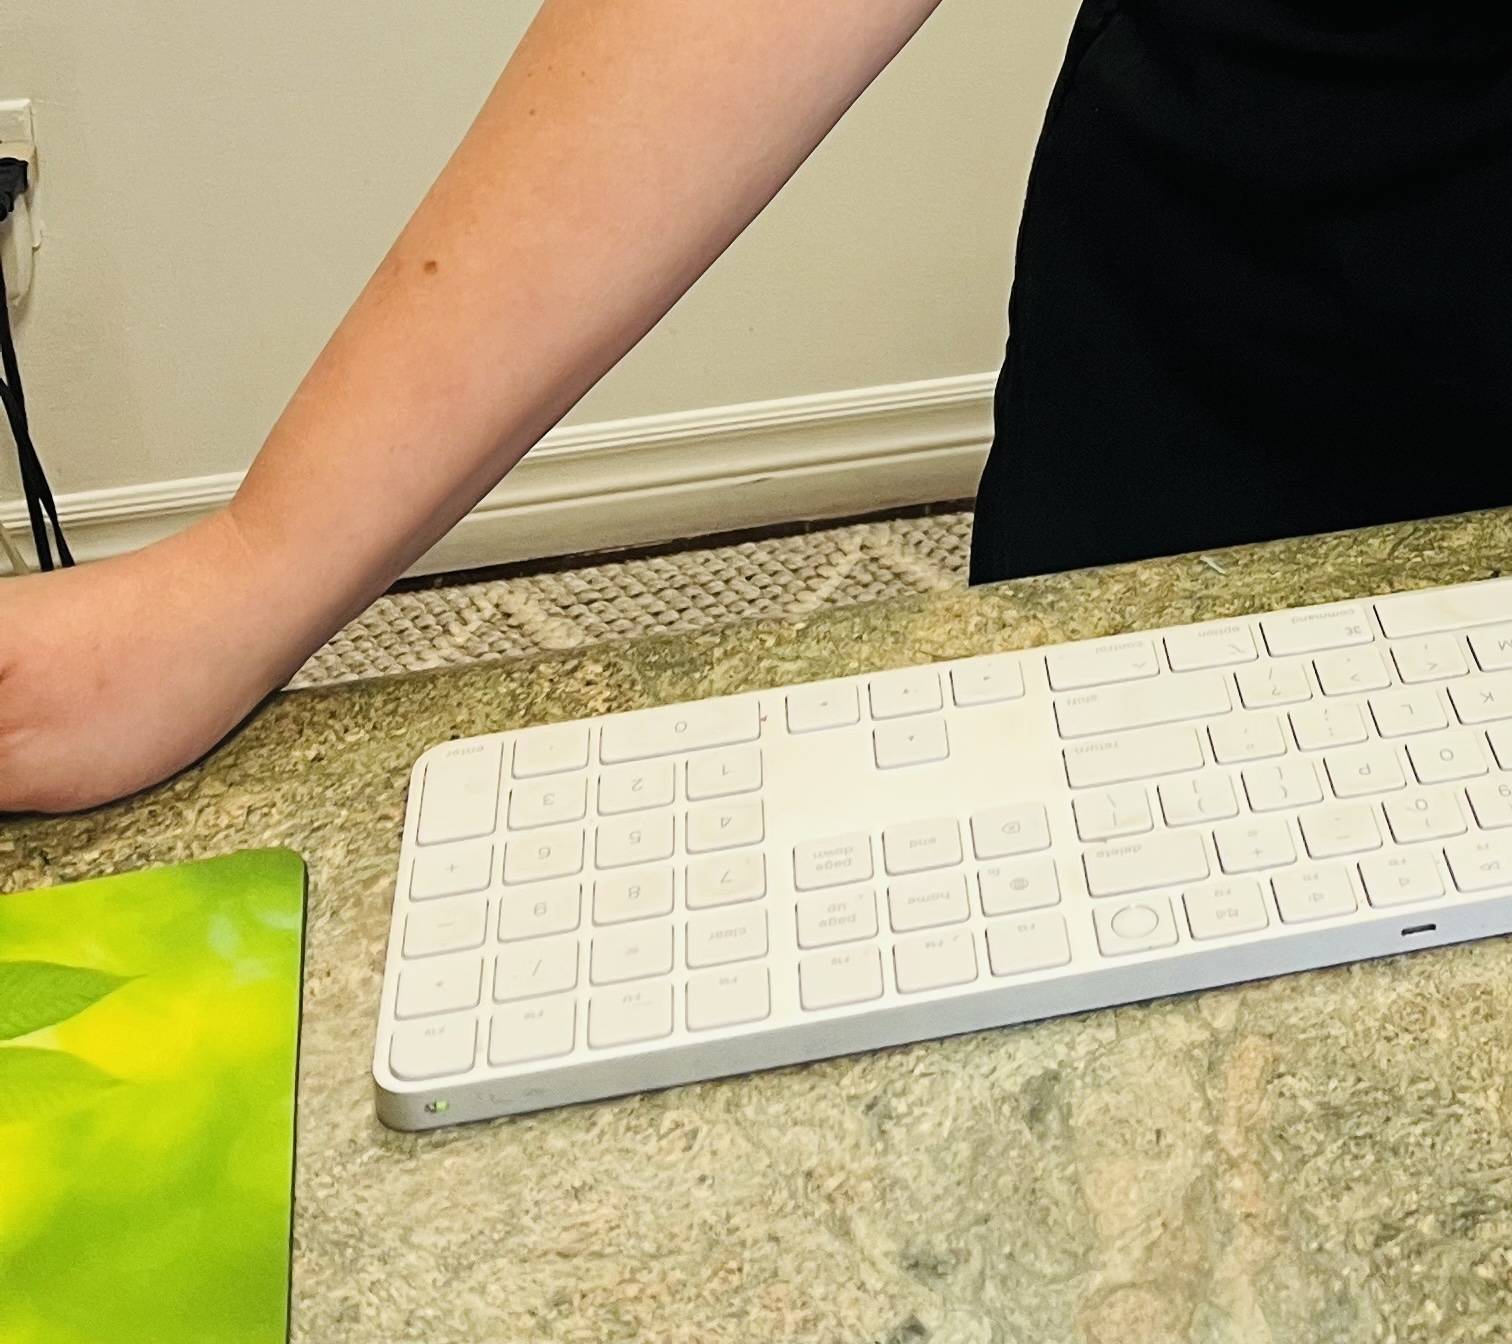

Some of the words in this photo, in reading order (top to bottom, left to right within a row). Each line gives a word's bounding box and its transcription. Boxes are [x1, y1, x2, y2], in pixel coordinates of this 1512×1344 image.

[1480, 691, 1495, 703] K
[1400, 704, 1413, 714] L
[674, 721, 687, 733] 0
[1439, 749, 1454, 761] O
[722, 764, 730, 776] 1
[1358, 763, 1371, 776] P
[631, 777, 643, 791] 2
[1498, 785, 1511, 797] 9
[542, 793, 555, 806] 3
[1415, 798, 1428, 811] 0
[720, 817, 732, 828] 4
[629, 831, 641, 844] 5
[538, 846, 551, 860] 6
[720, 870, 731, 884] 7
[628, 886, 640, 900] 8
[533, 902, 547, 917] 9
